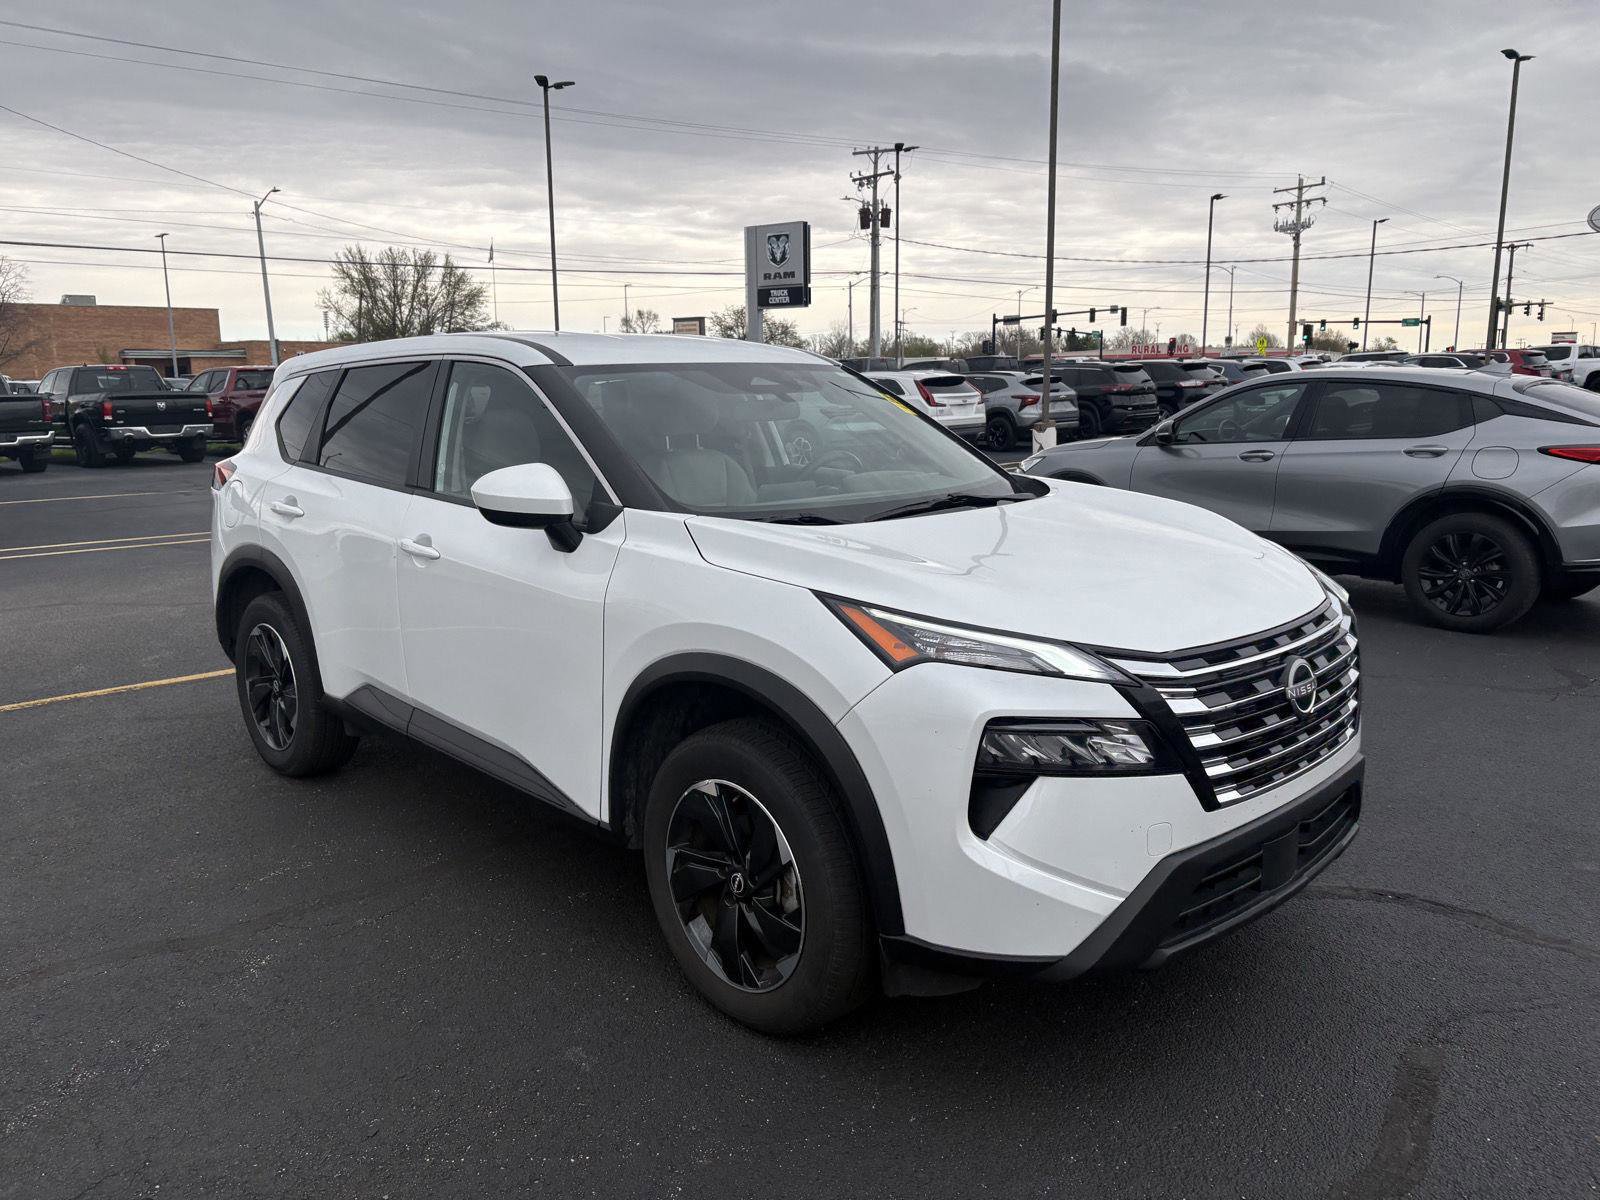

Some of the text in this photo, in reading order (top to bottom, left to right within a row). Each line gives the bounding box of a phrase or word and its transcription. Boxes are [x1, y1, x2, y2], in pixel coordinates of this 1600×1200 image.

[763, 271, 796, 281] RAM
[770, 289, 788, 297] TRUCK
[768, 296, 790, 304] CENTER
[1131, 345, 1161, 354] RURAL
